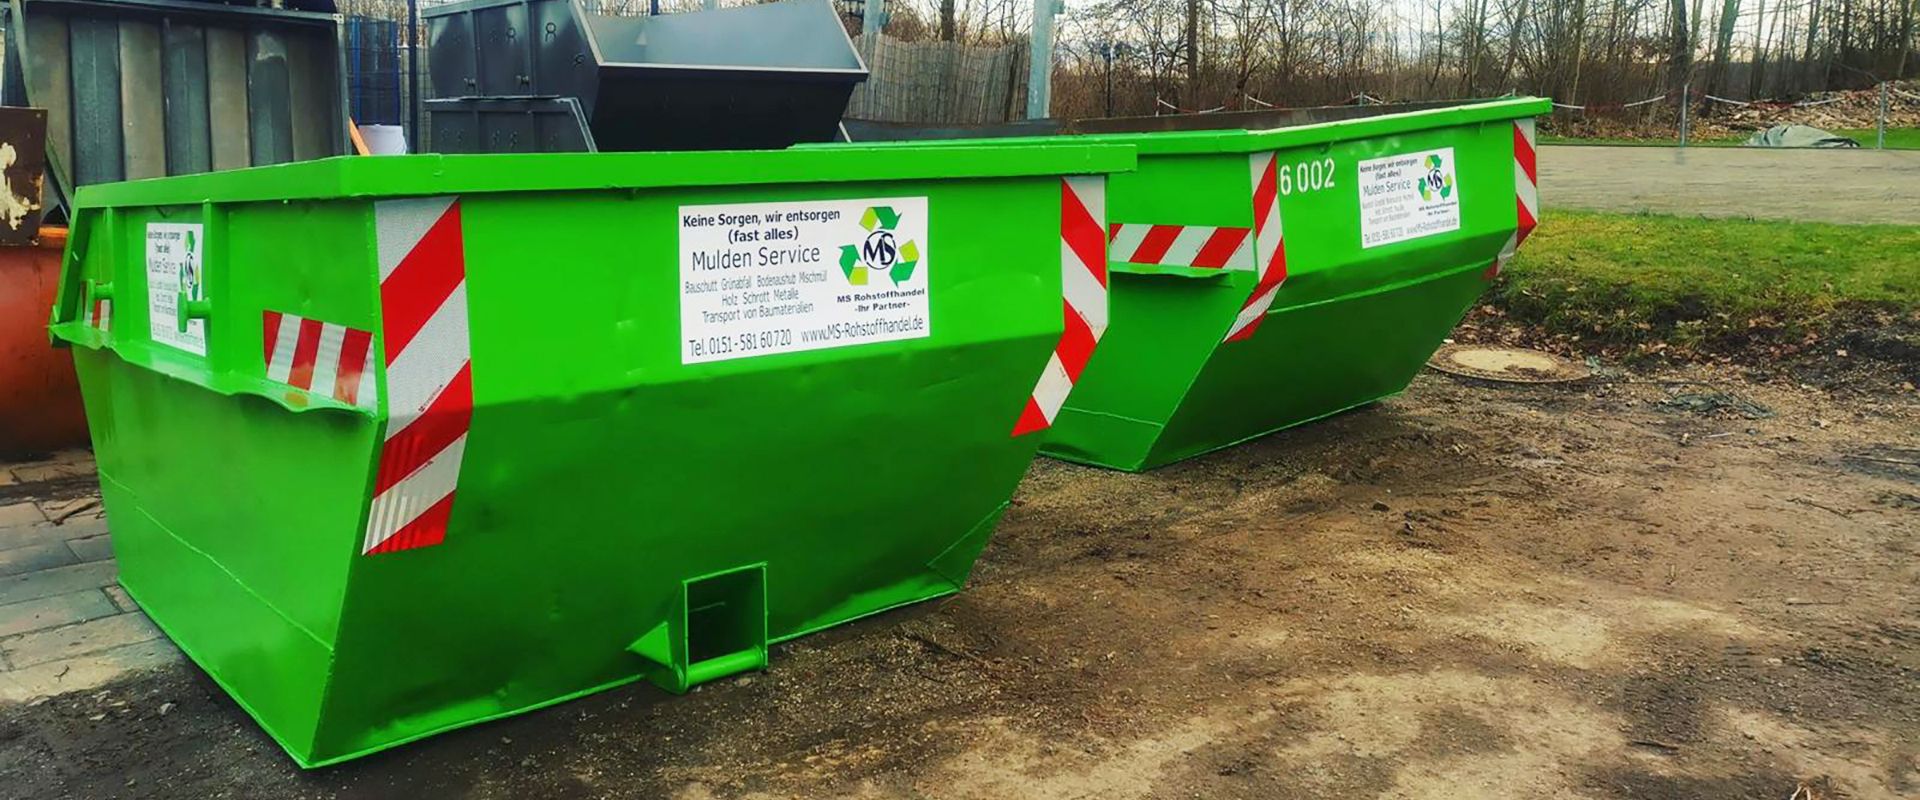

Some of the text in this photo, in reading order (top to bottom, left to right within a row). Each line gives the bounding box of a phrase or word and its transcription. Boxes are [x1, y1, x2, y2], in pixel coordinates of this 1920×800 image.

[1386, 179, 1411, 192] Service
[683, 209, 840, 228] Keine Sorgen, wir entsorgen
[728, 226, 799, 244] (fast alles)
[692, 244, 820, 271] Mulden Service
[864, 232, 896, 266] MS
[685, 280, 718, 294] Bauschutt
[837, 288, 925, 303] MS Rohstoffhandel
[721, 288, 799, 306] Holz Schrott Metalle
[702, 309, 740, 324] Transport
[744, 308, 757, 319] von
[801, 314, 924, 342] www.MS-Rohstoffhandel.de
[689, 338, 708, 357] Tel.
